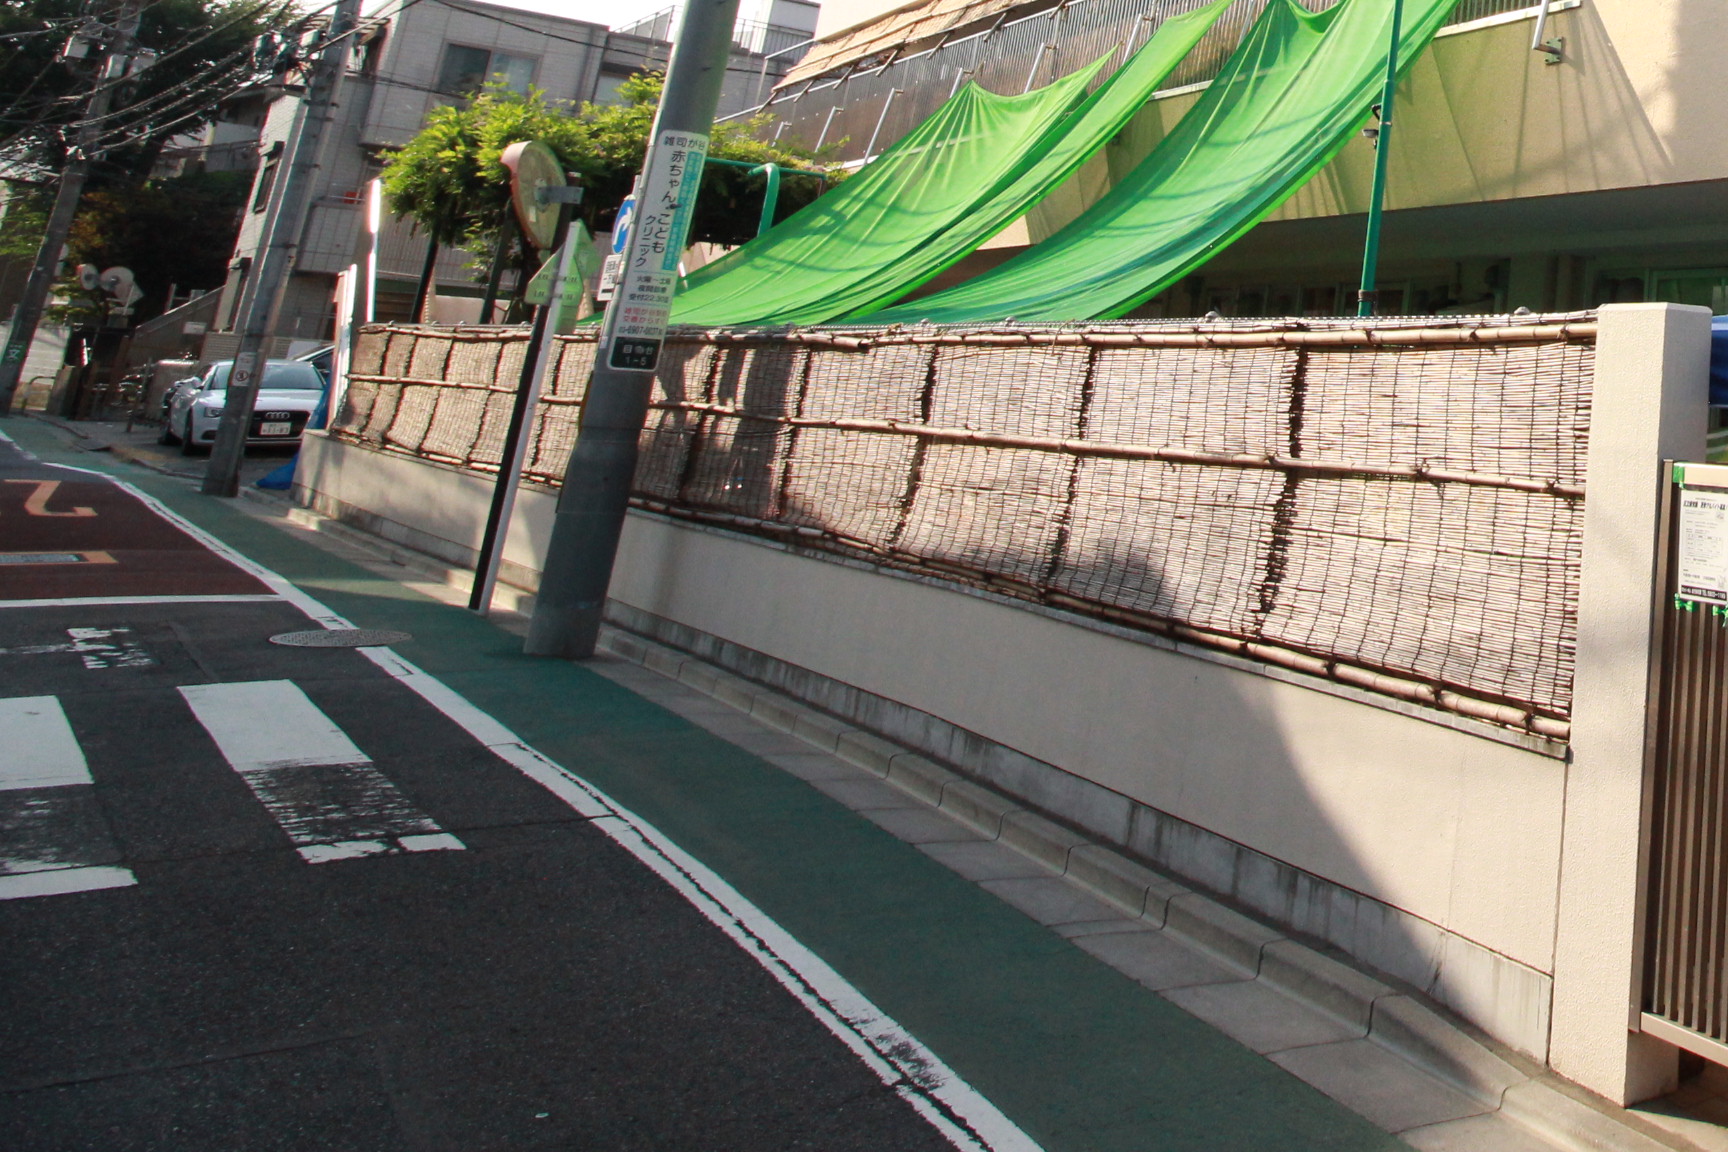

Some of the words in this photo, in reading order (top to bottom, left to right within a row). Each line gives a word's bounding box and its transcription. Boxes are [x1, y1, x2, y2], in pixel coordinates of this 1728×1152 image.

[664, 136, 706, 151] 雑司が谷
[634, 214, 656, 268] クリニック
